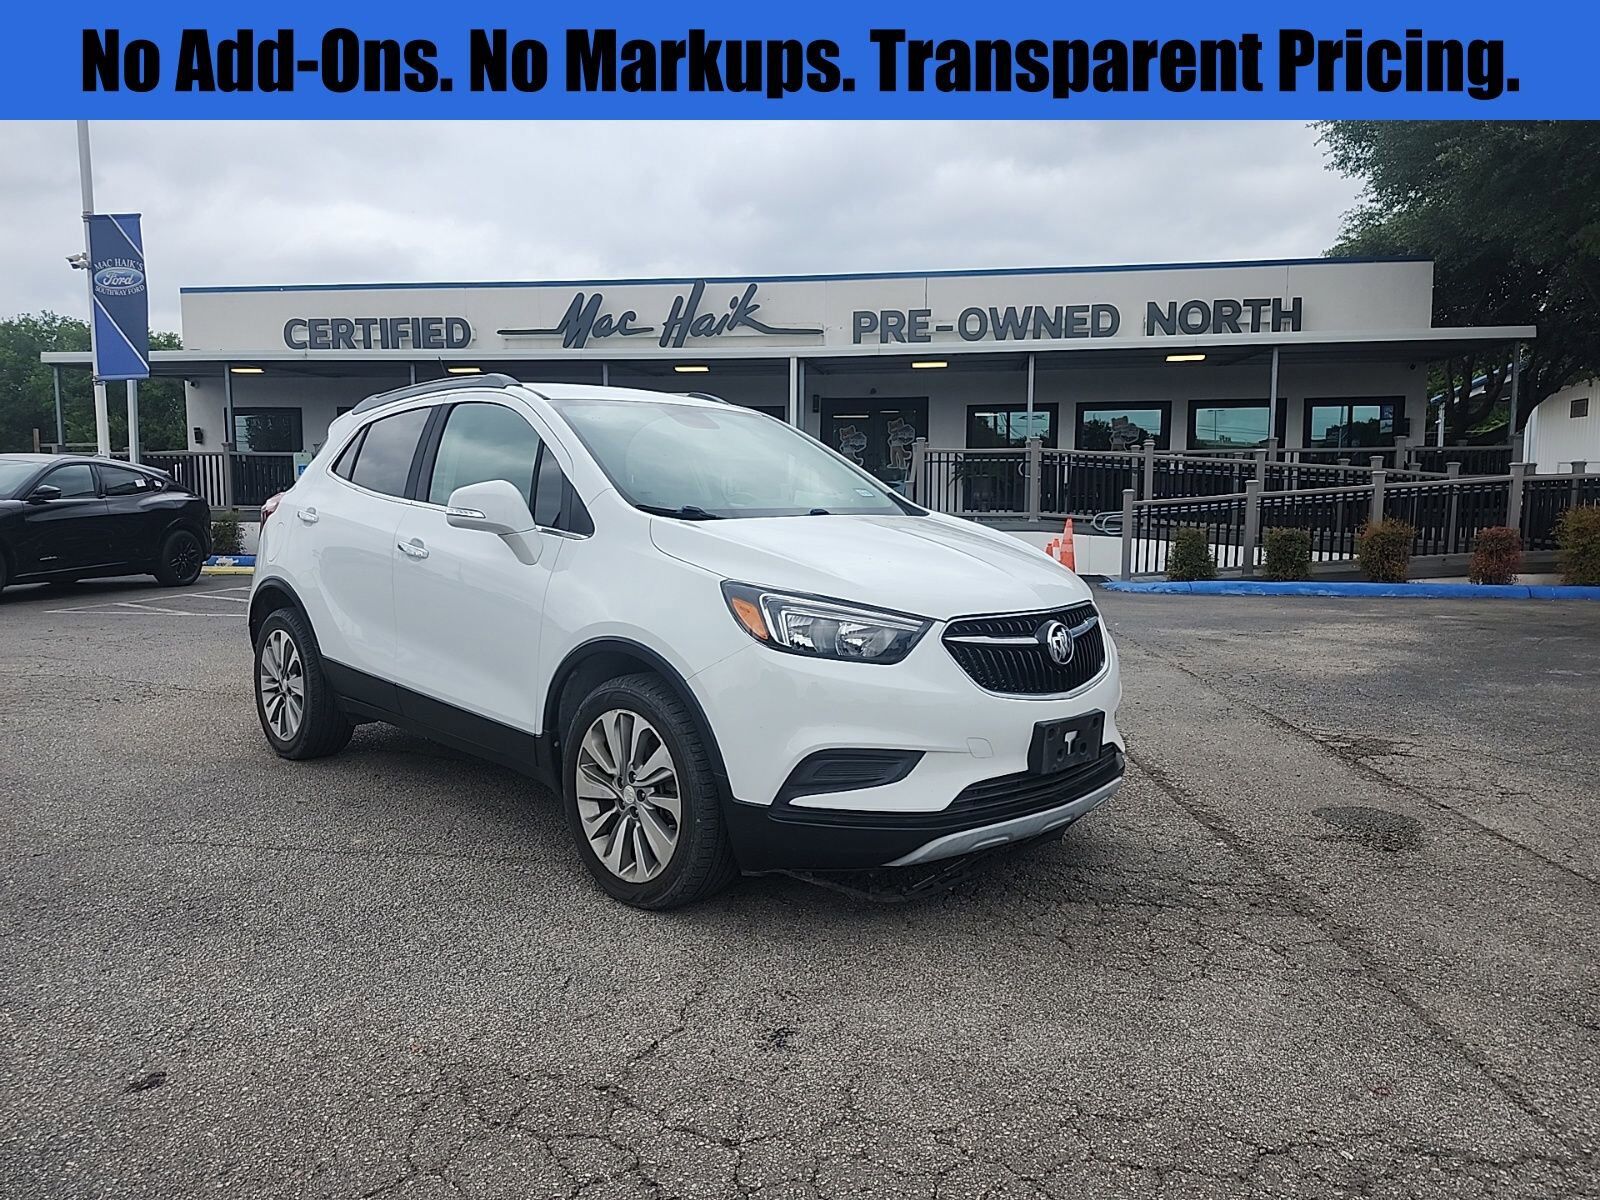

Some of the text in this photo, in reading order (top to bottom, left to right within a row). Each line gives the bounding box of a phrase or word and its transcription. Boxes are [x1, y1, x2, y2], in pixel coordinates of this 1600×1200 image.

[93, 259, 113, 271] MAC
[94, 284, 145, 296] SOUTHWAY FORD
[103, 271, 135, 286] Ford
[497, 279, 824, 349] Mac Haik
[852, 297, 1303, 345] PRE-OWNED NORTH
[283, 316, 471, 350] CERTIFIED
